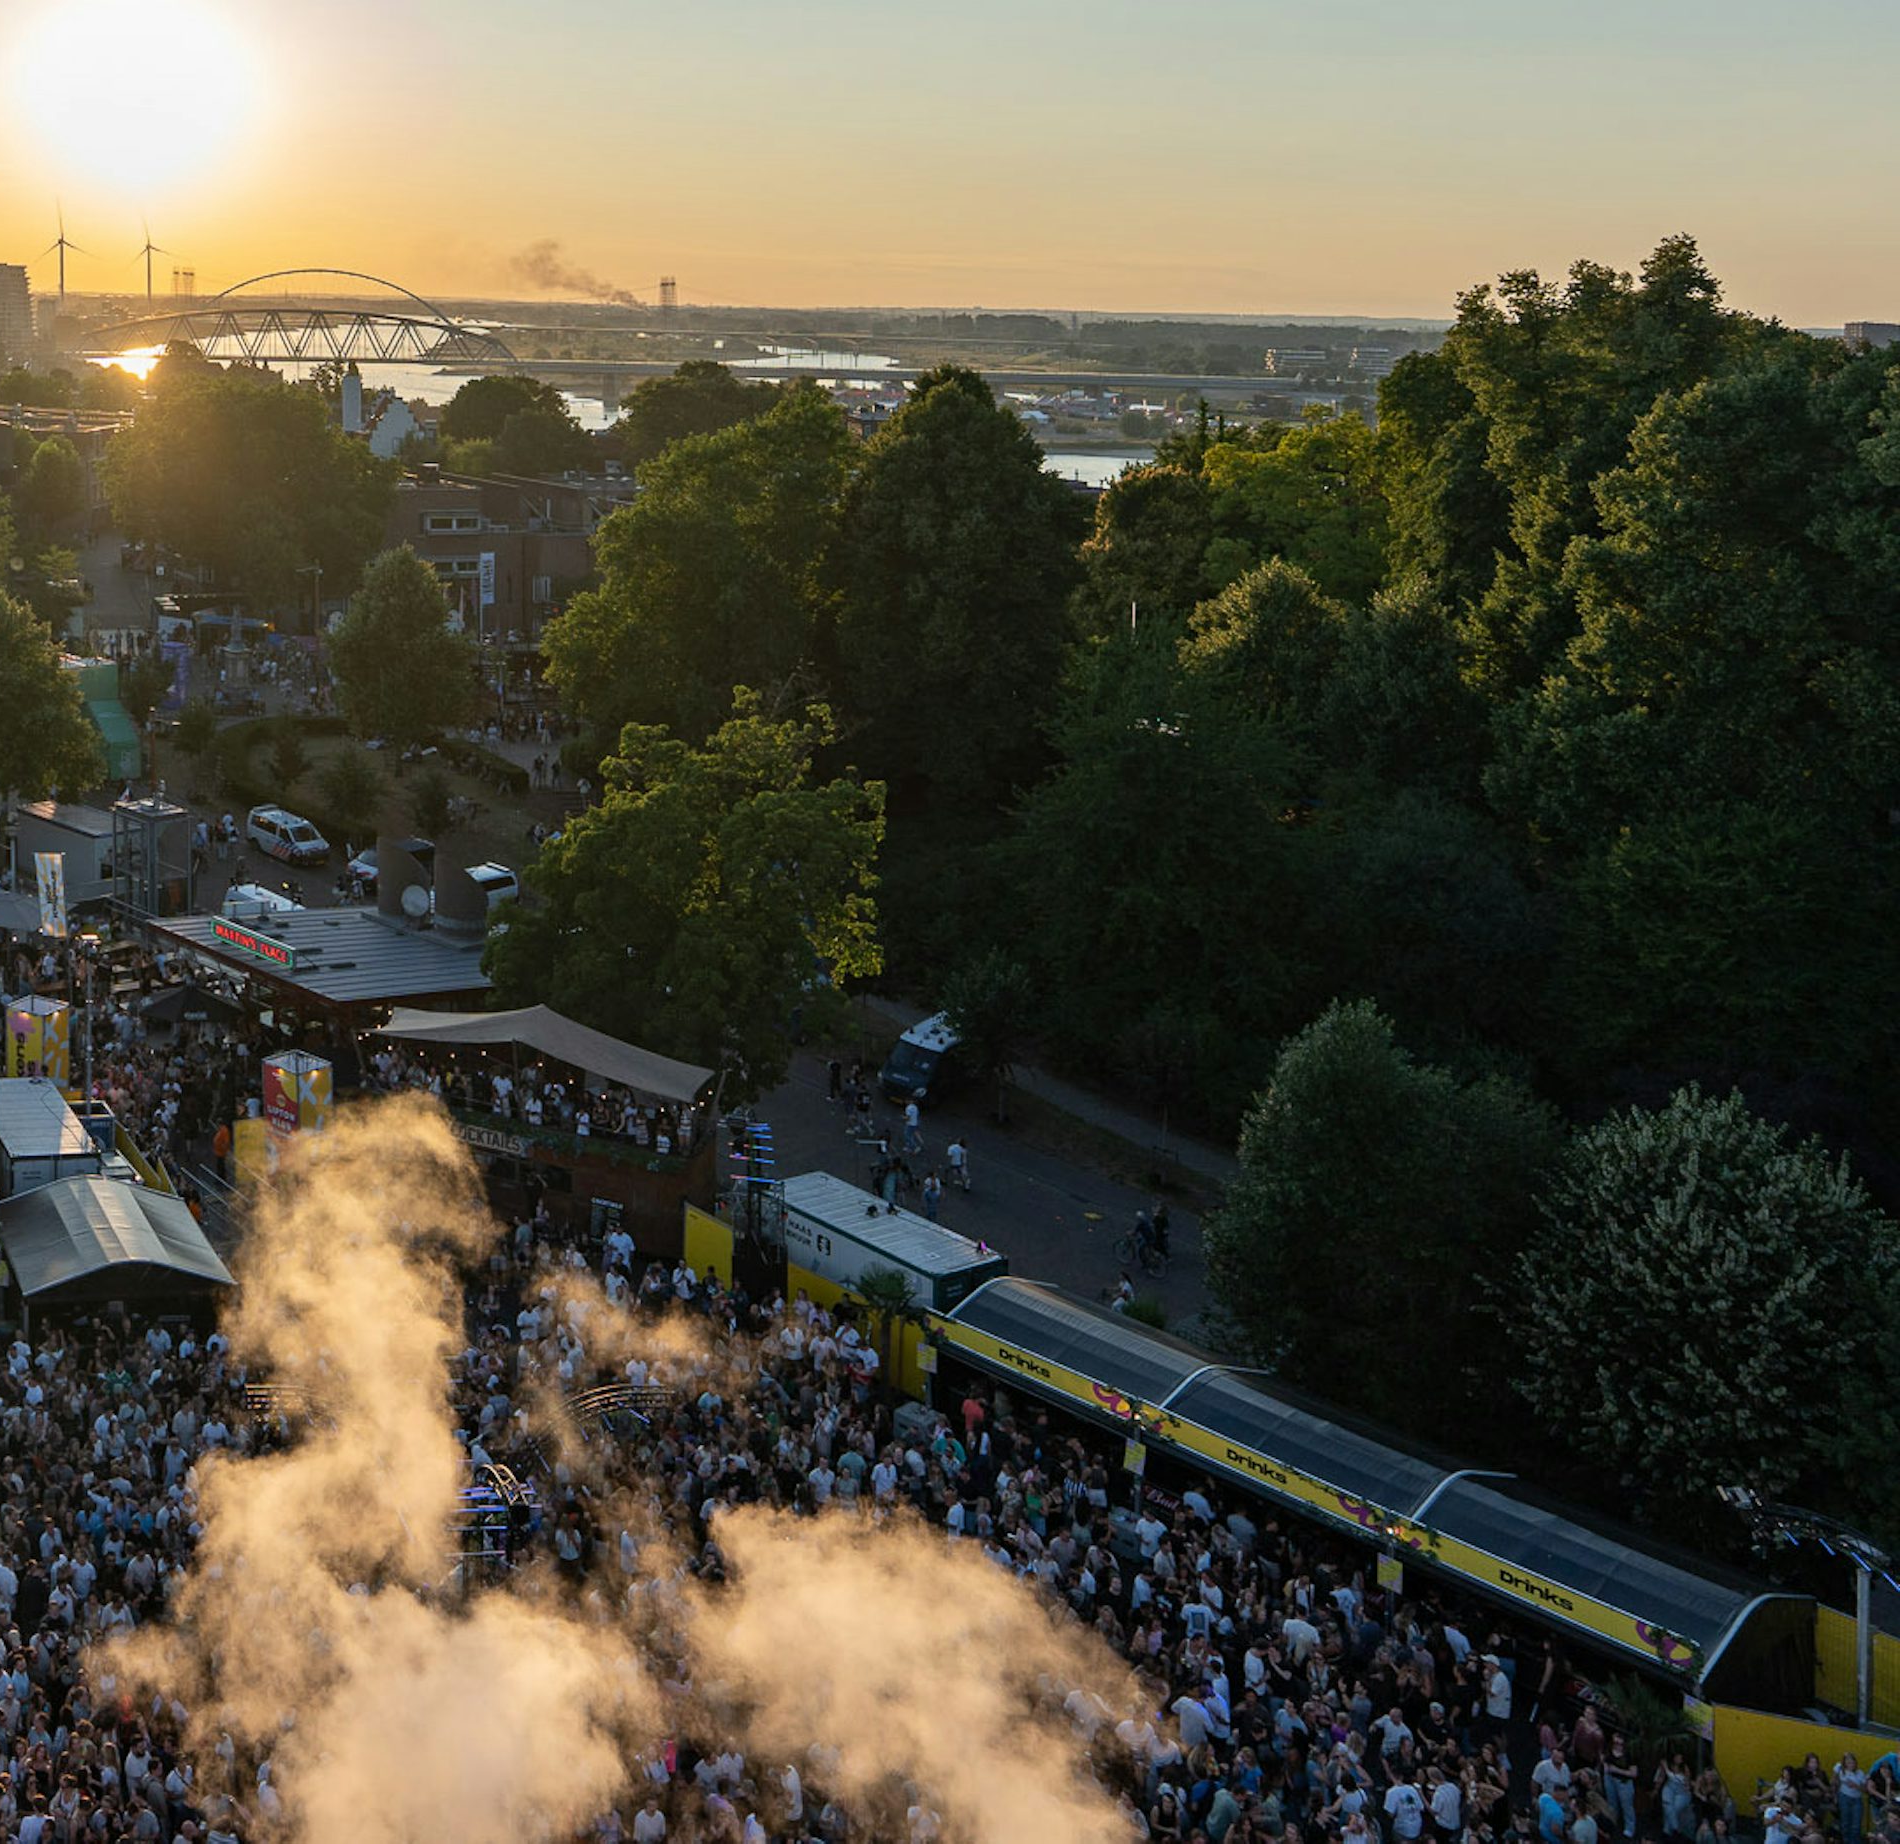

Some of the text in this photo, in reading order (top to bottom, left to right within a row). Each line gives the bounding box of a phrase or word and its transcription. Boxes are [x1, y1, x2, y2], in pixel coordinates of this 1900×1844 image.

[999, 1348, 1050, 1378] Drinks
[1226, 1447, 1288, 1485] Drinks
[1500, 1570, 1573, 1611] Drinks
